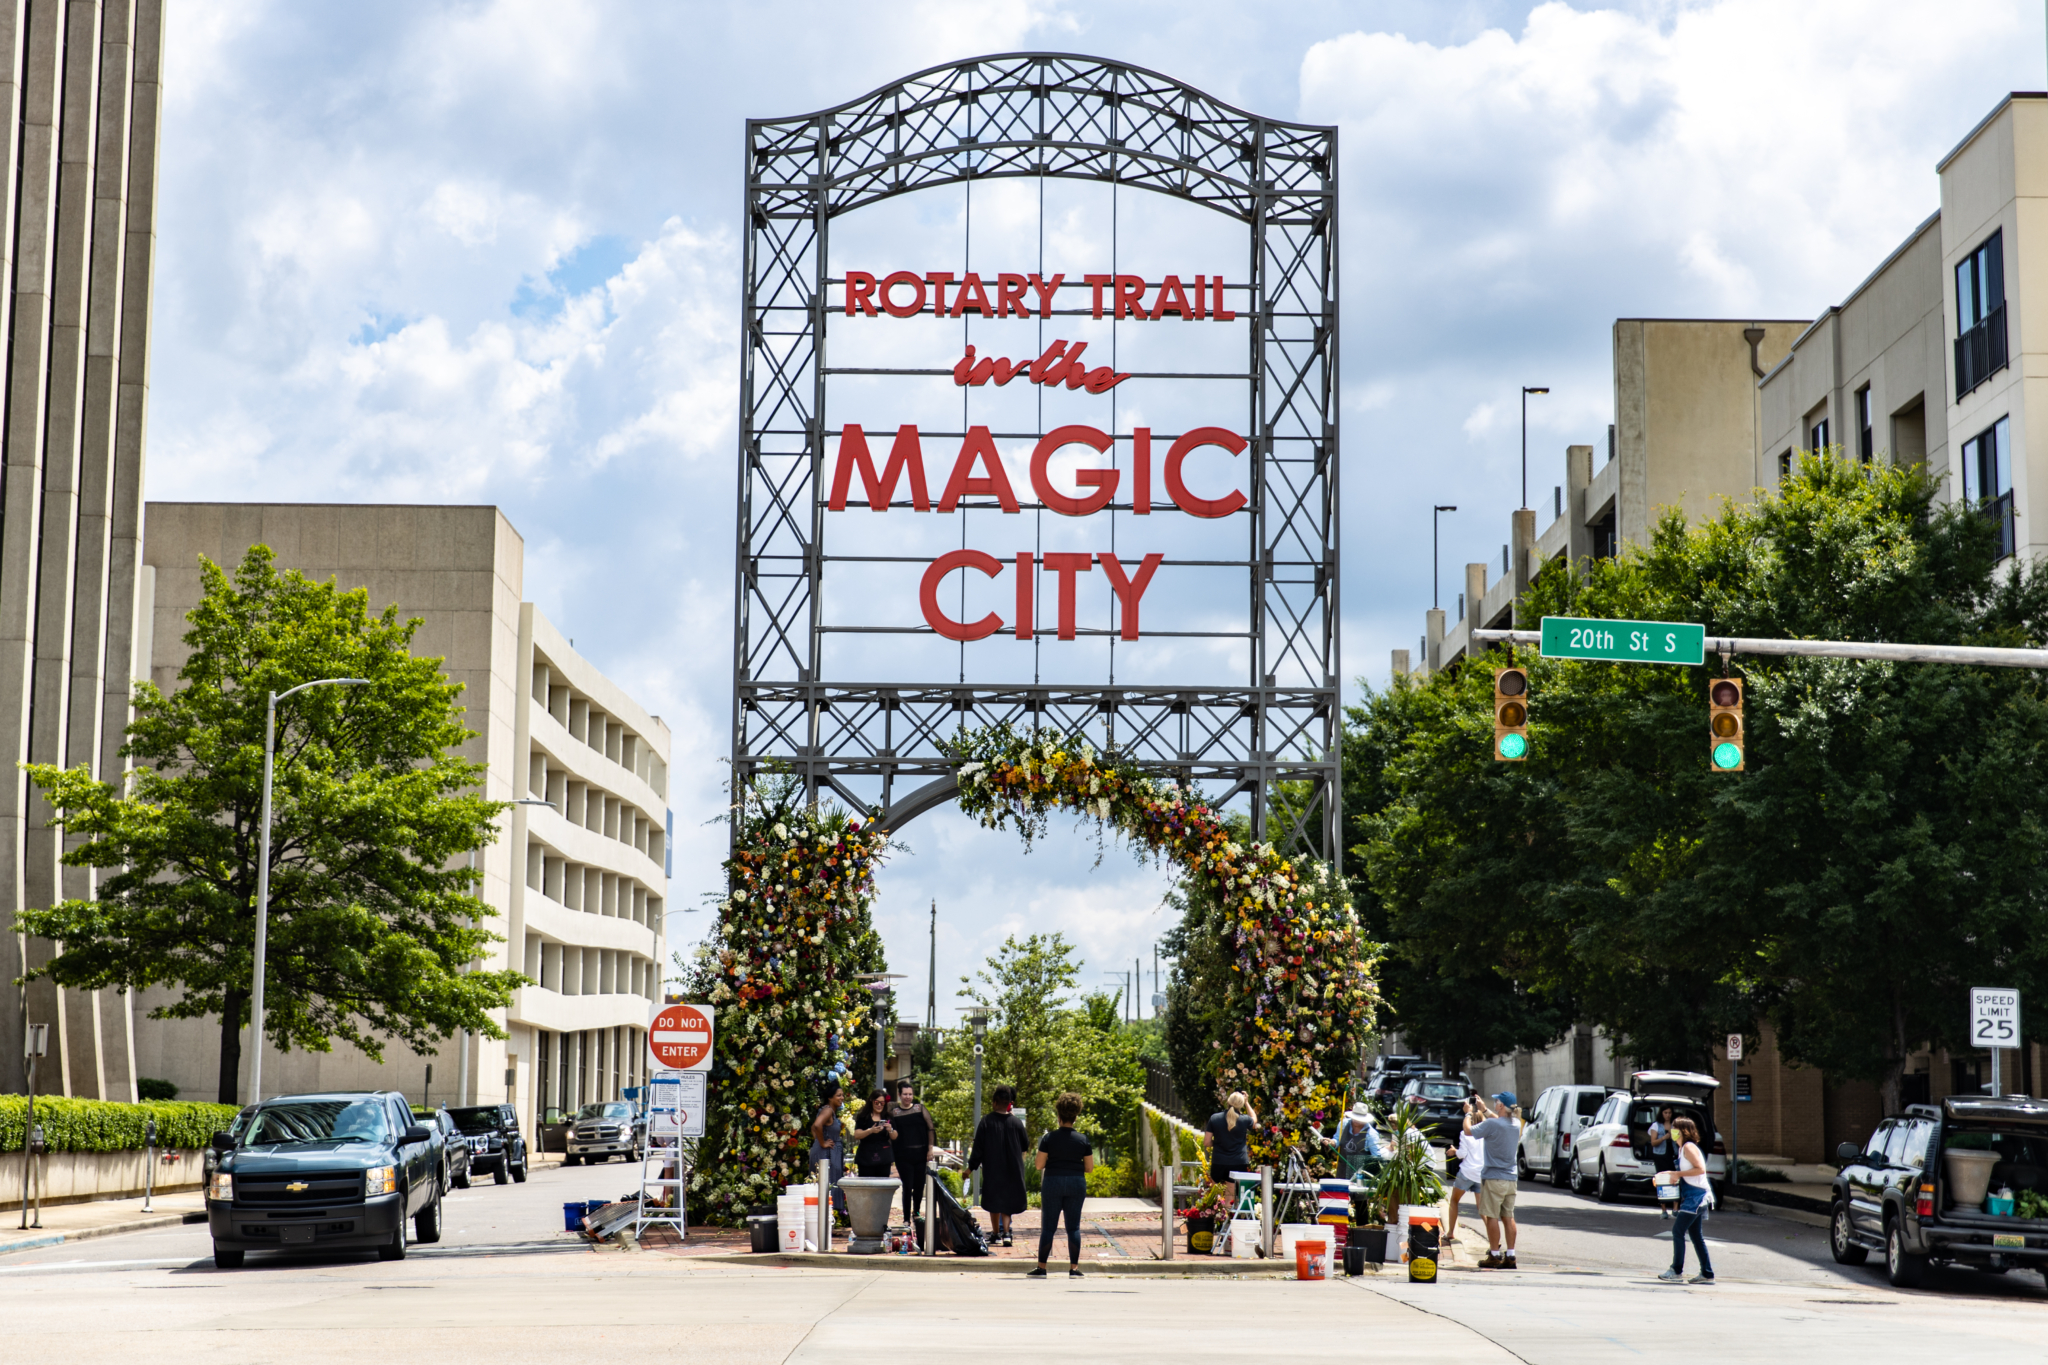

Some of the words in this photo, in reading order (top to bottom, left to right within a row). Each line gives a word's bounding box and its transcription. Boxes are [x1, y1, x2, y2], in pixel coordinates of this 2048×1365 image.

[845, 270, 1065, 319] ROTARY
[1084, 274, 1236, 321] TRAIL
[954, 344, 1033, 387] in
[1029, 339, 1131, 394] the
[828, 424, 1249, 518] MAGIC
[919, 549, 1164, 641] CITY
[1570, 628, 1614, 650] 20th
[1629, 631, 1649, 651] St
[1664, 633, 1676, 653] S
[1976, 995, 2014, 1005] SPEED
[659, 1017, 674, 1028] DO
[681, 1018, 703, 1028] NOT
[1980, 1007, 2010, 1016] LIMIT
[1977, 1019, 2013, 1039] 25
[662, 1046, 698, 1057] ENTER
